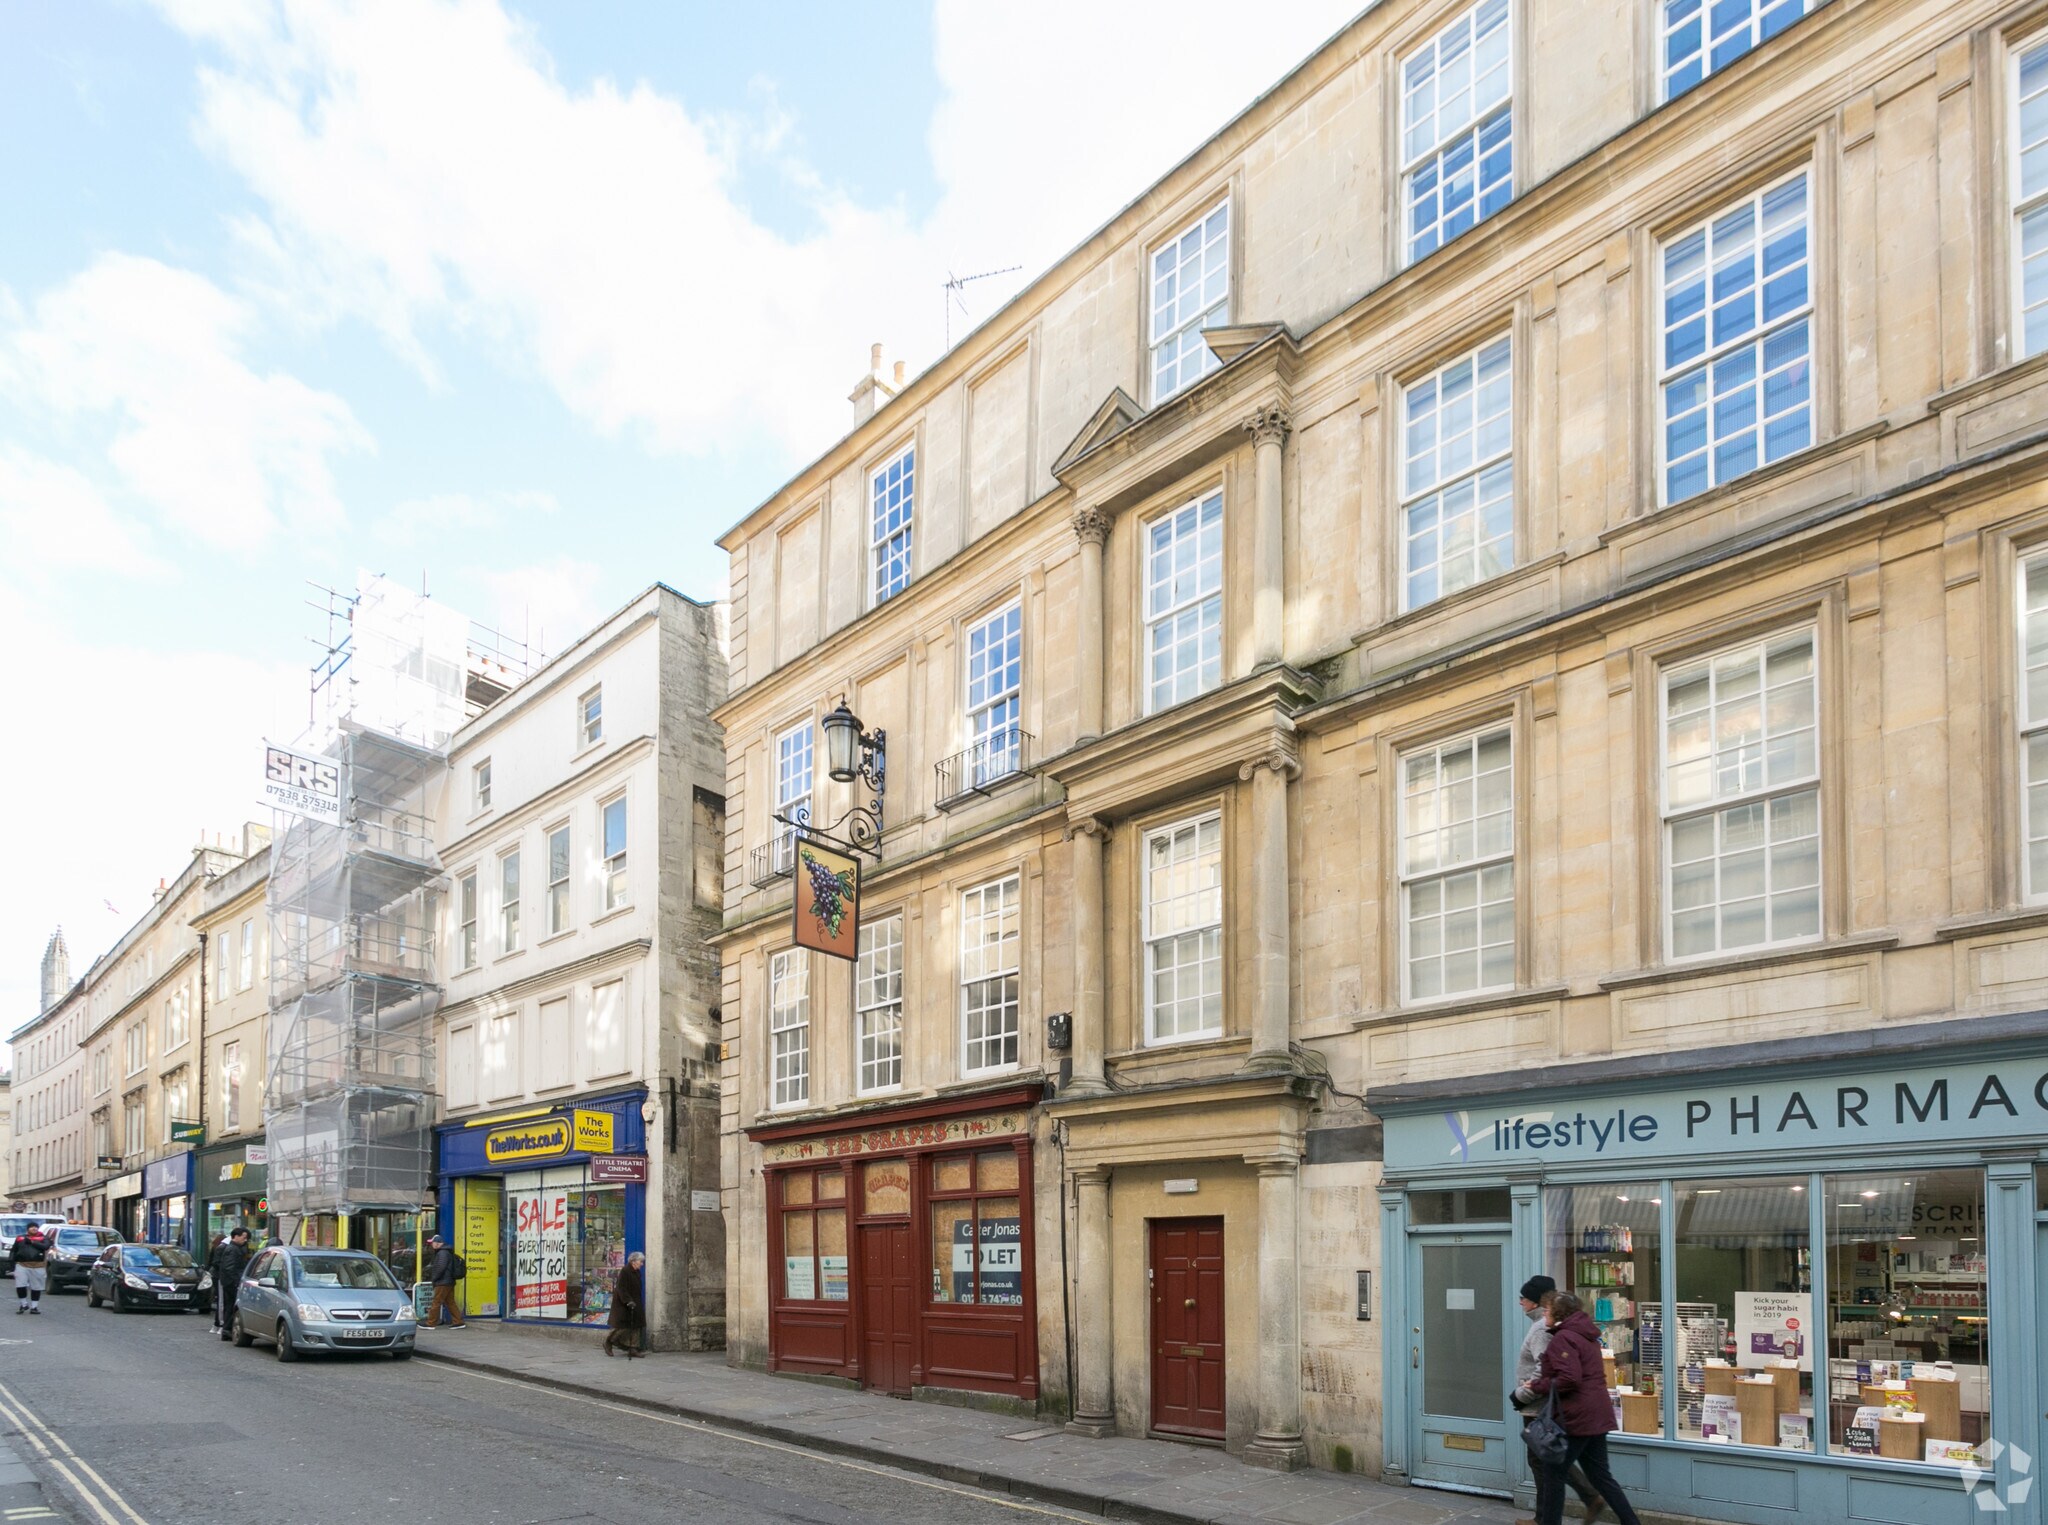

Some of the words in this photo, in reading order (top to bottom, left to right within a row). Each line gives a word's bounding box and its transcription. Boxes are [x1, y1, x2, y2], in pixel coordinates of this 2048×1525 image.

[267, 748, 338, 797] SRS
[266, 785, 299, 801] 07538
[302, 795, 338, 812] 575318
[585, 1117, 603, 1127] The
[1494, 1109, 1659, 1152] lifestyle
[173, 1128, 204, 1139] SUBWAY
[490, 1128, 564, 1154] TheWorks.co.uk
[579, 1127, 609, 1138] Works
[824, 1135, 862, 1156] THE
[867, 1122, 947, 1151] GRAPES
[219, 1161, 247, 1182] SUBWAY
[867, 1174, 909, 1193] GRAPES
[518, 1198, 566, 1235] SALE
[992, 1222, 1020, 1239] Jonas
[518, 1240, 566, 1255] EVERYTHING
[988, 1249, 1016, 1265] LET
[518, 1258, 545, 1278] MUST
[546, 1256, 566, 1278] GO!
[1187, 1259, 1197, 1269] 14
